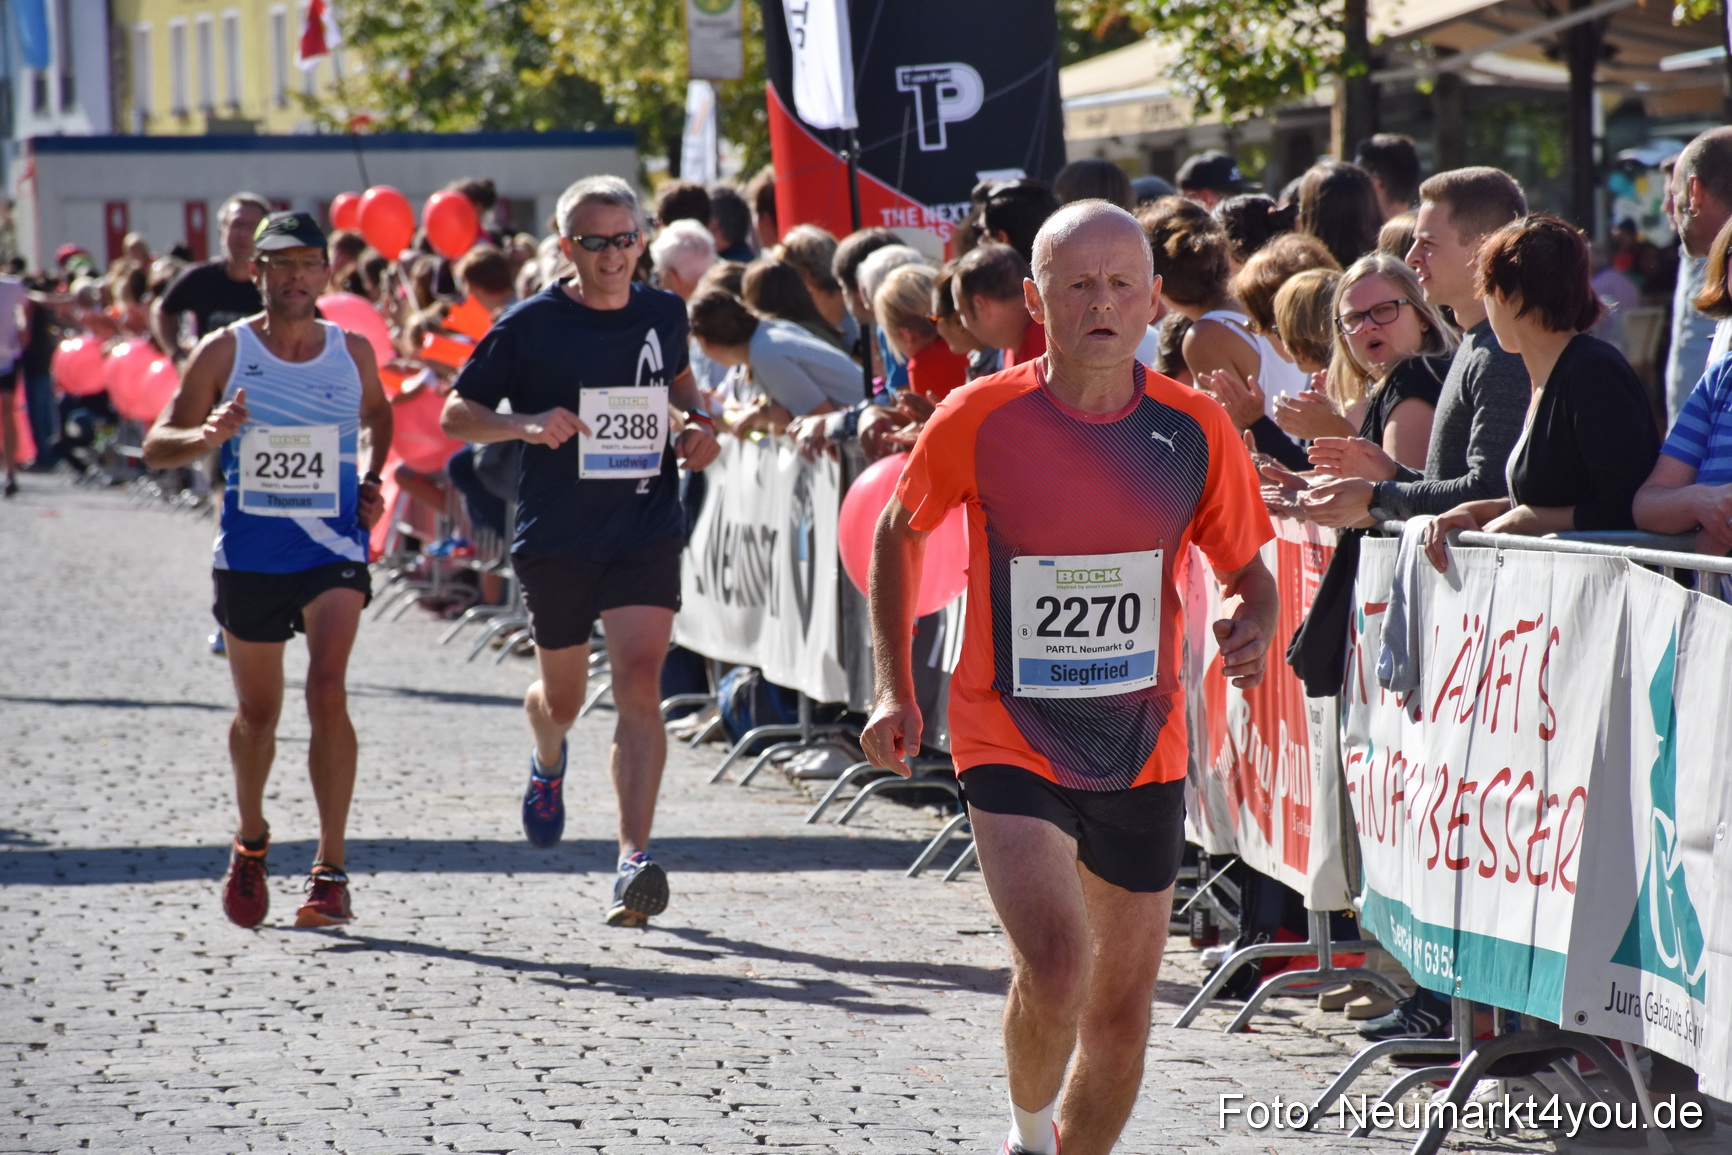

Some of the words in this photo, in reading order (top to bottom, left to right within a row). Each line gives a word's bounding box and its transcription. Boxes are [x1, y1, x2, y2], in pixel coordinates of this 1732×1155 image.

[880, 207, 919, 229] THE
[922, 201, 971, 224] NEXT
[596, 414, 659, 440] 2388
[255, 452, 324, 479] 2324
[609, 455, 649, 469] Ludwig
[266, 494, 312, 507] Thomas
[1056, 567, 1122, 584] BOCK
[1101, 582, 1123, 590] concepts
[1036, 592, 1141, 638] 2270
[1022, 628, 1028, 636] B
[1046, 645, 1078, 654] PARTL
[1079, 643, 1122, 654] Neumarkt
[1050, 660, 1129, 685] Siegfried
[1604, 981, 1641, 1018] Jura
